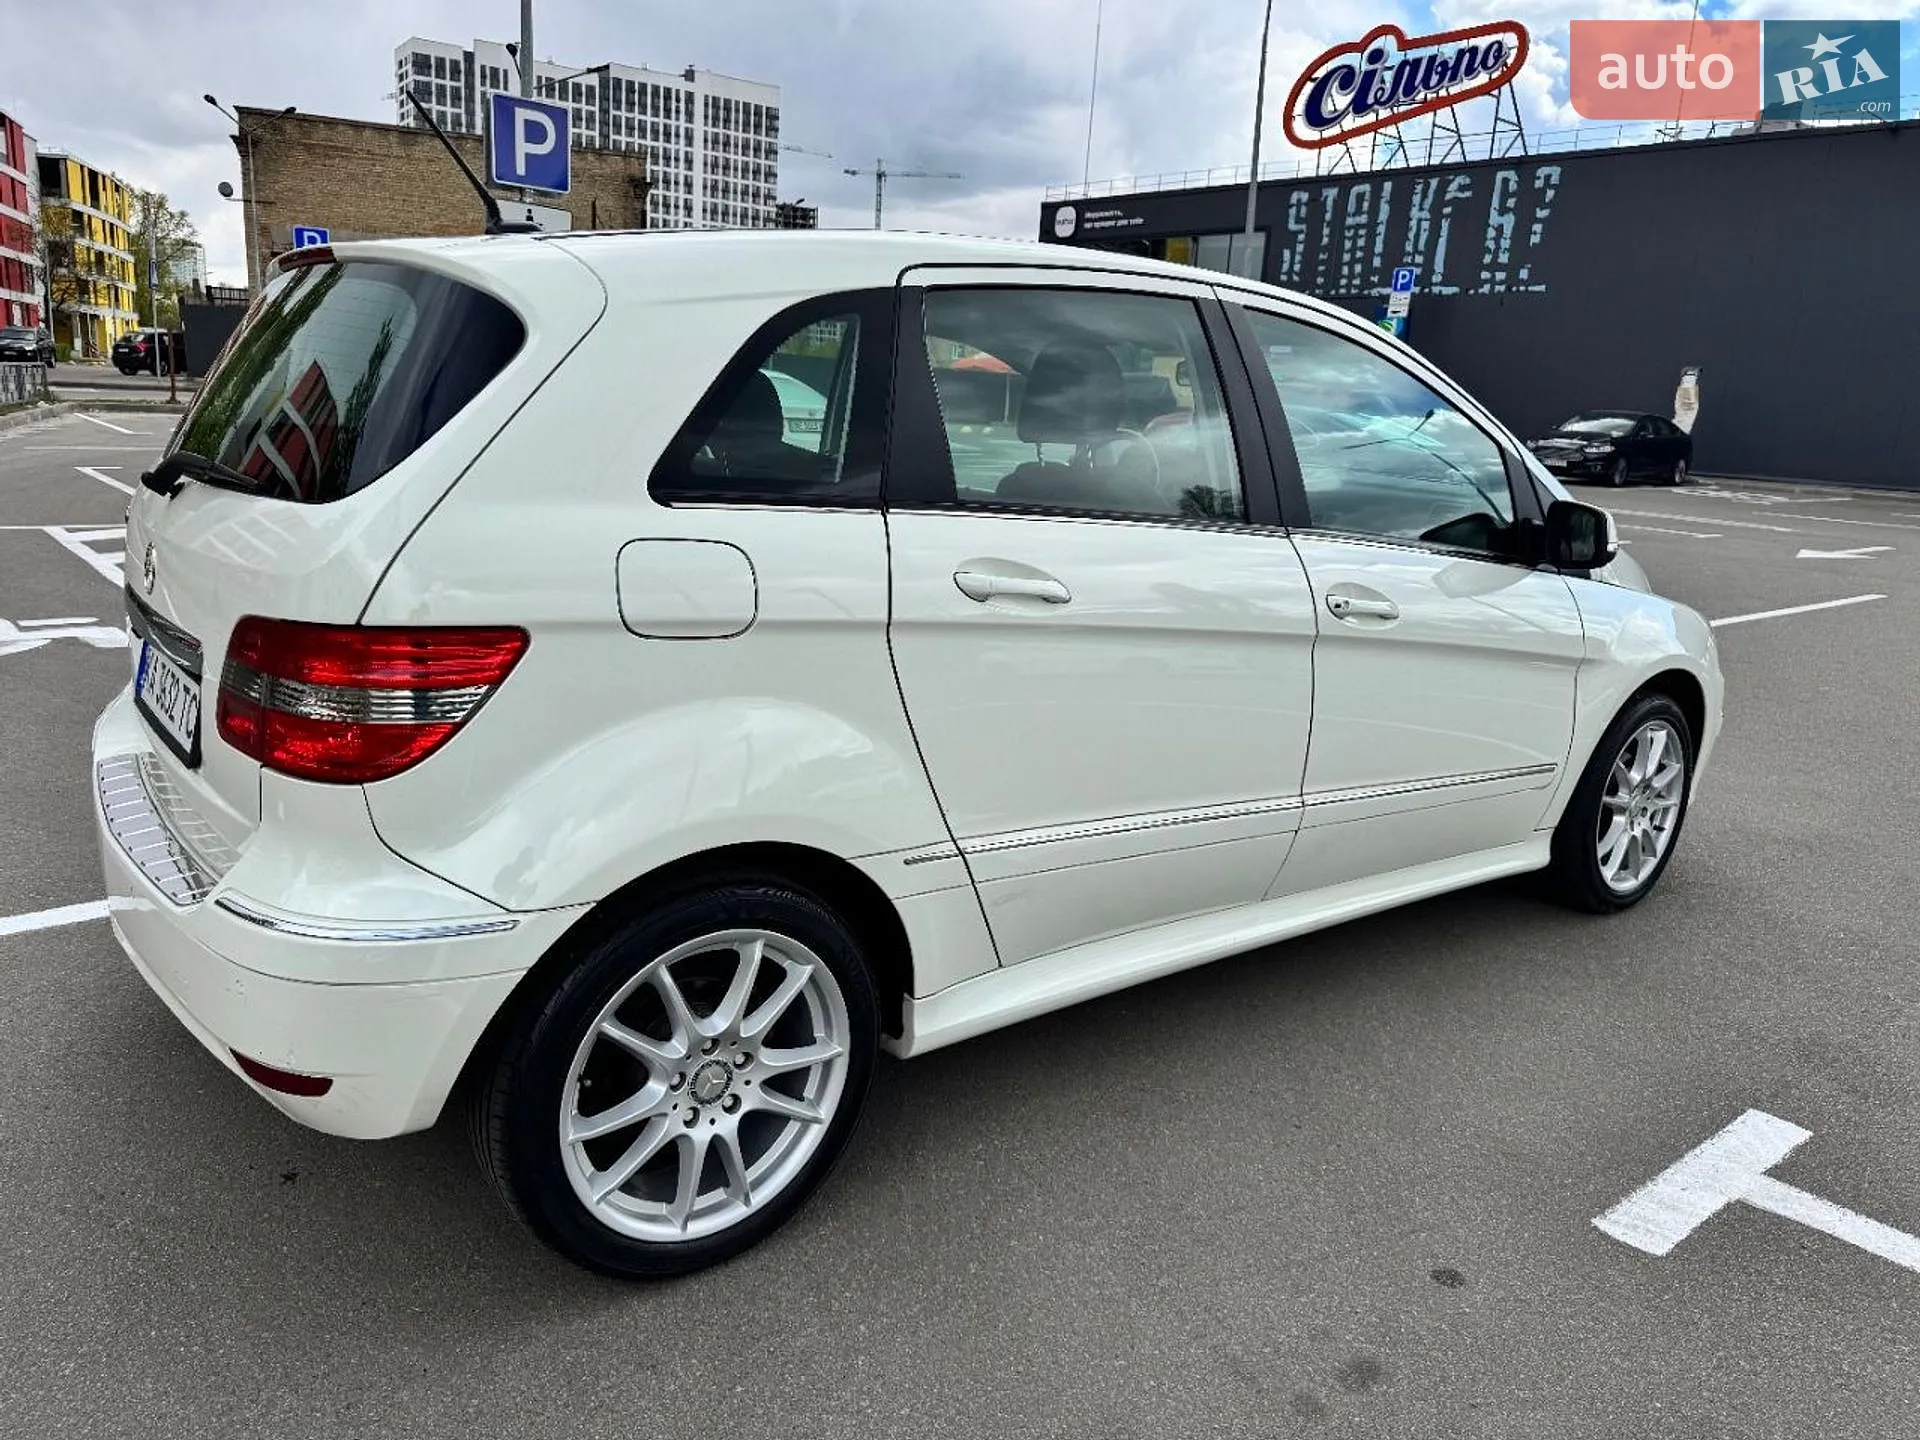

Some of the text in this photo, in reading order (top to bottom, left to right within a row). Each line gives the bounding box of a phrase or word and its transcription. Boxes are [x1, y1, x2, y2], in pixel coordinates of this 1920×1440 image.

[1304, 40, 1509, 131] Сільпо
[515, 107, 556, 176] P
[303, 231, 321, 249] P
[1397, 270, 1410, 291] P
